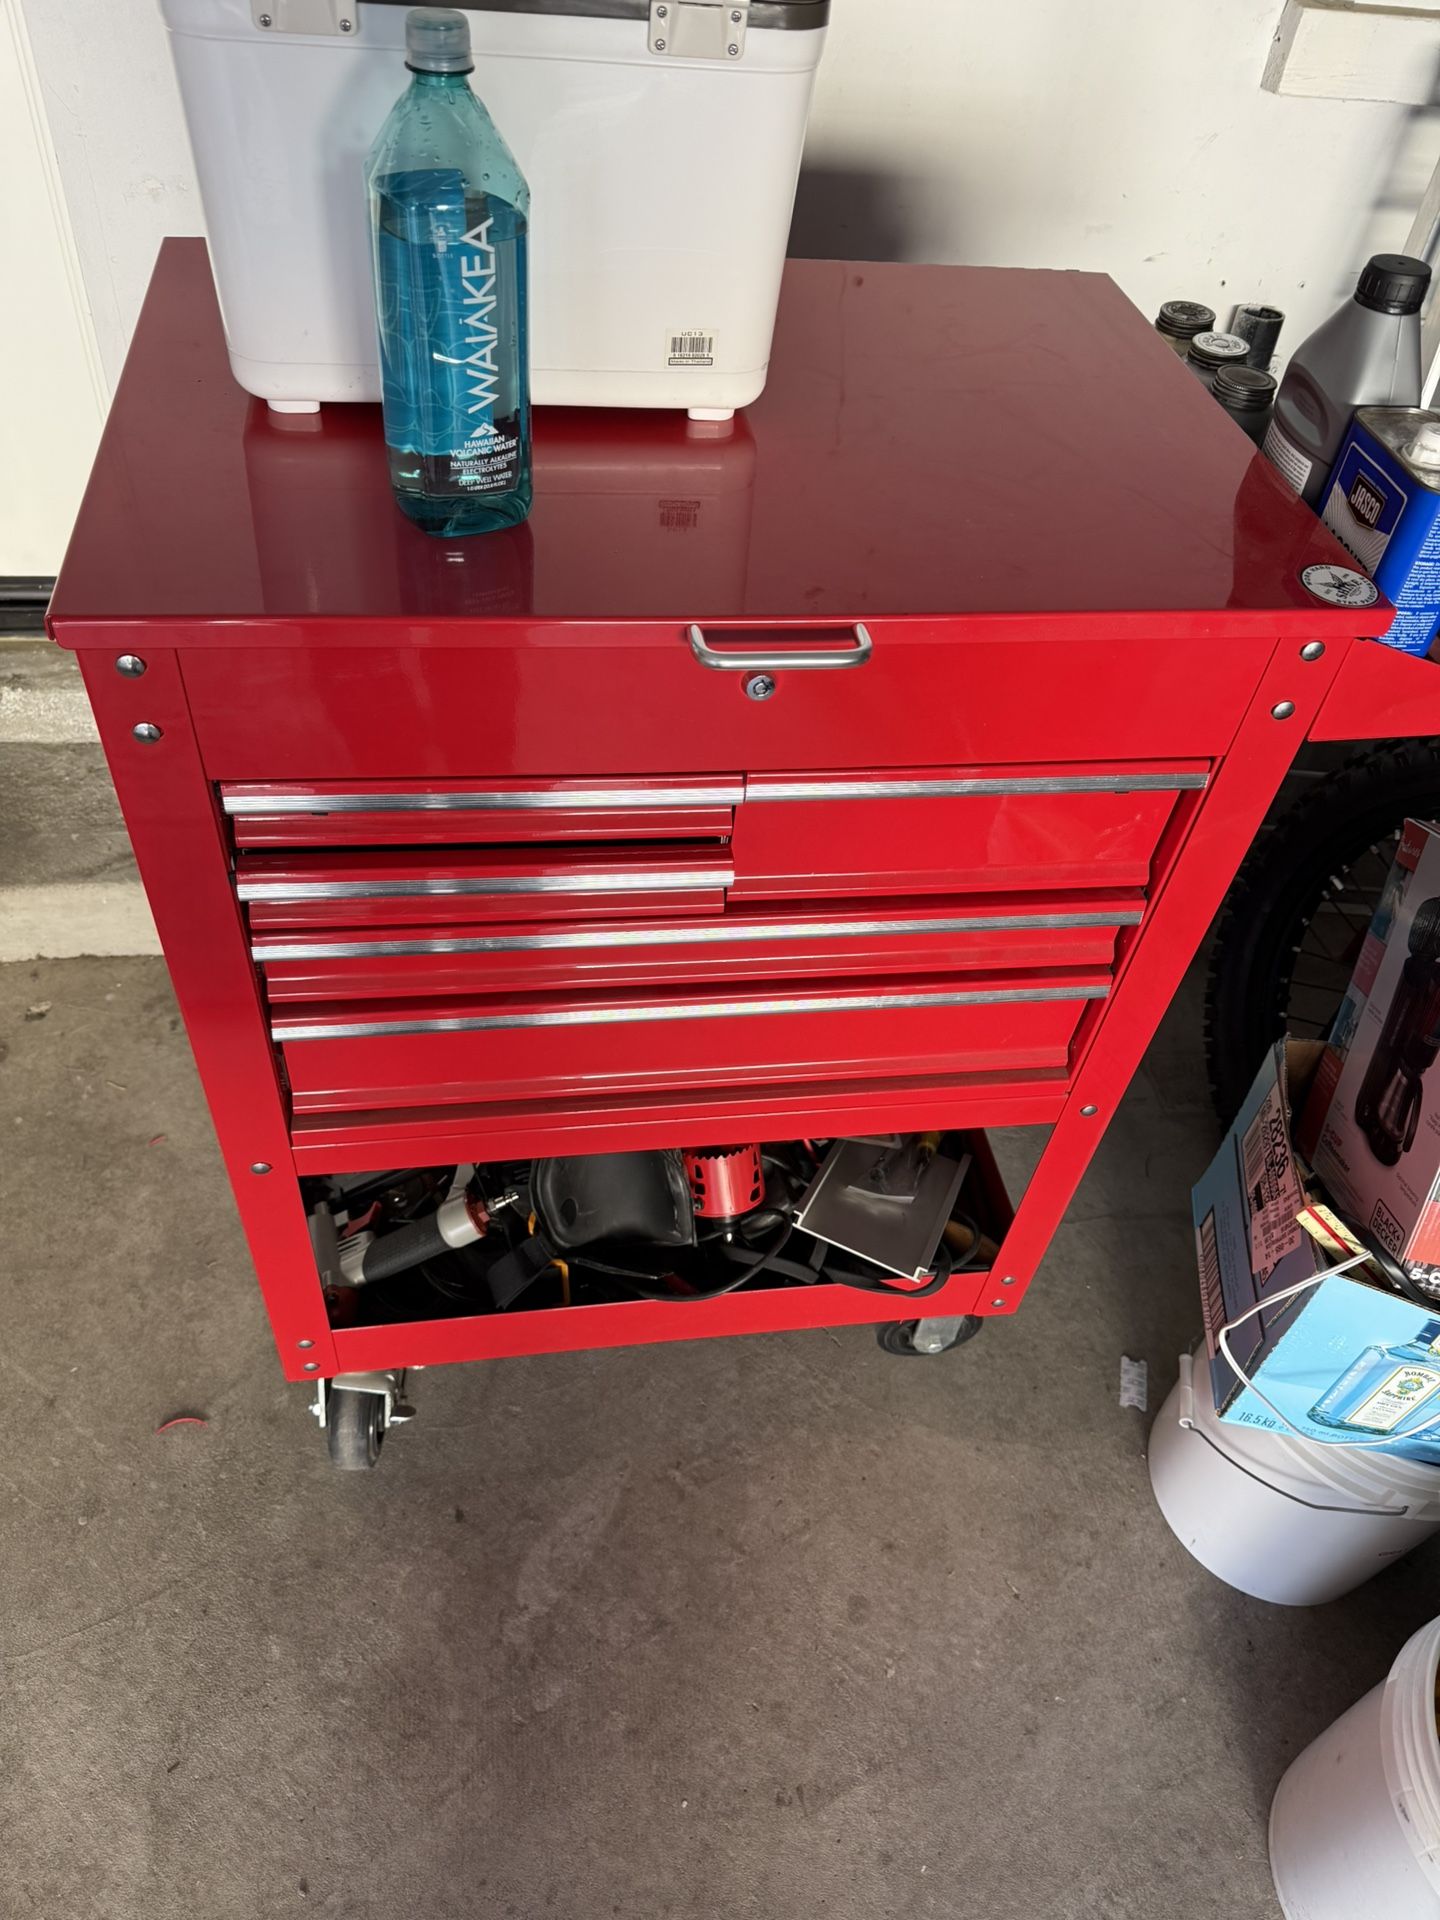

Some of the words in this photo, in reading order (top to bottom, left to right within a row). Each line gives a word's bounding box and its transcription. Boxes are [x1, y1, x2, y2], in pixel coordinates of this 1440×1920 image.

[450, 446, 493, 458] VOLCANIC
[493, 438, 517, 452] WATER
[464, 435, 505, 449] HAWAIIAN
[450, 459, 489, 468] NATURALLY
[490, 450, 517, 463] ALKALINE
[463, 462, 508, 475] ELECTROLYTES
[1350, 484, 1381, 524] JASCO
[1336, 579, 1362, 599] SHINE
[1269, 1108, 1290, 1178] 28236
[1376, 1206, 1401, 1241] BLACK+
[1372, 1217, 1398, 1253] DECKER
[1404, 1370, 1436, 1384] BOMBAY
[1381, 1389, 1416, 1402] SAPPHIRE
